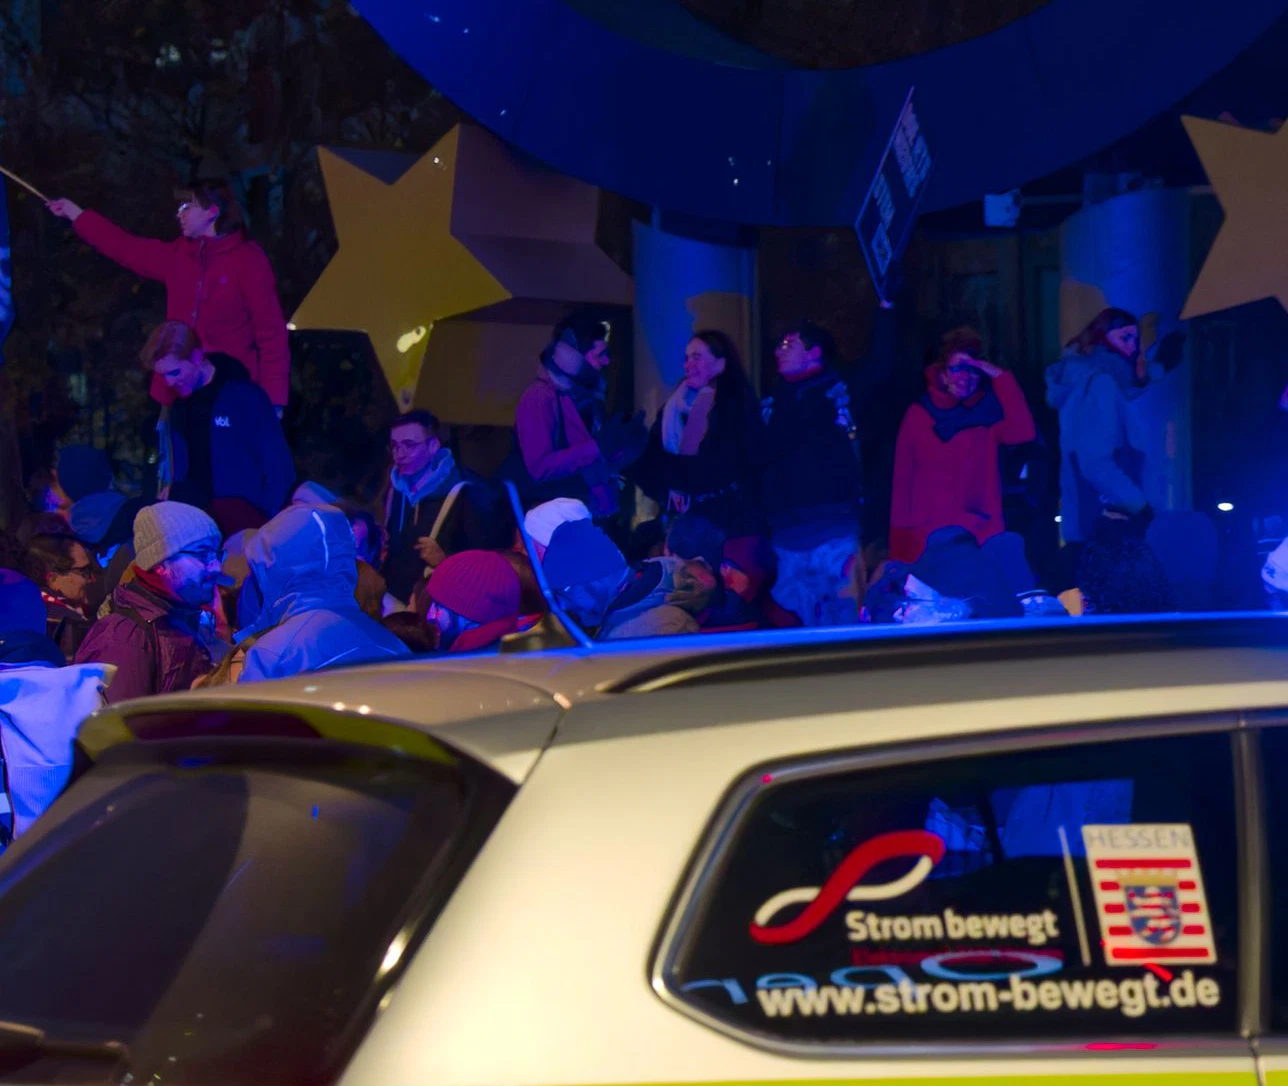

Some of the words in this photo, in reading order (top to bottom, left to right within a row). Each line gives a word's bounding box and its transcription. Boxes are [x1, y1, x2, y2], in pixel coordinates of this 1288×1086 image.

[1086, 828, 1191, 851] HESSEN
[845, 910, 942, 942] Strom
[943, 908, 1059, 945] bewegt
[756, 971, 1221, 1018] www.strom-bewegt.de
